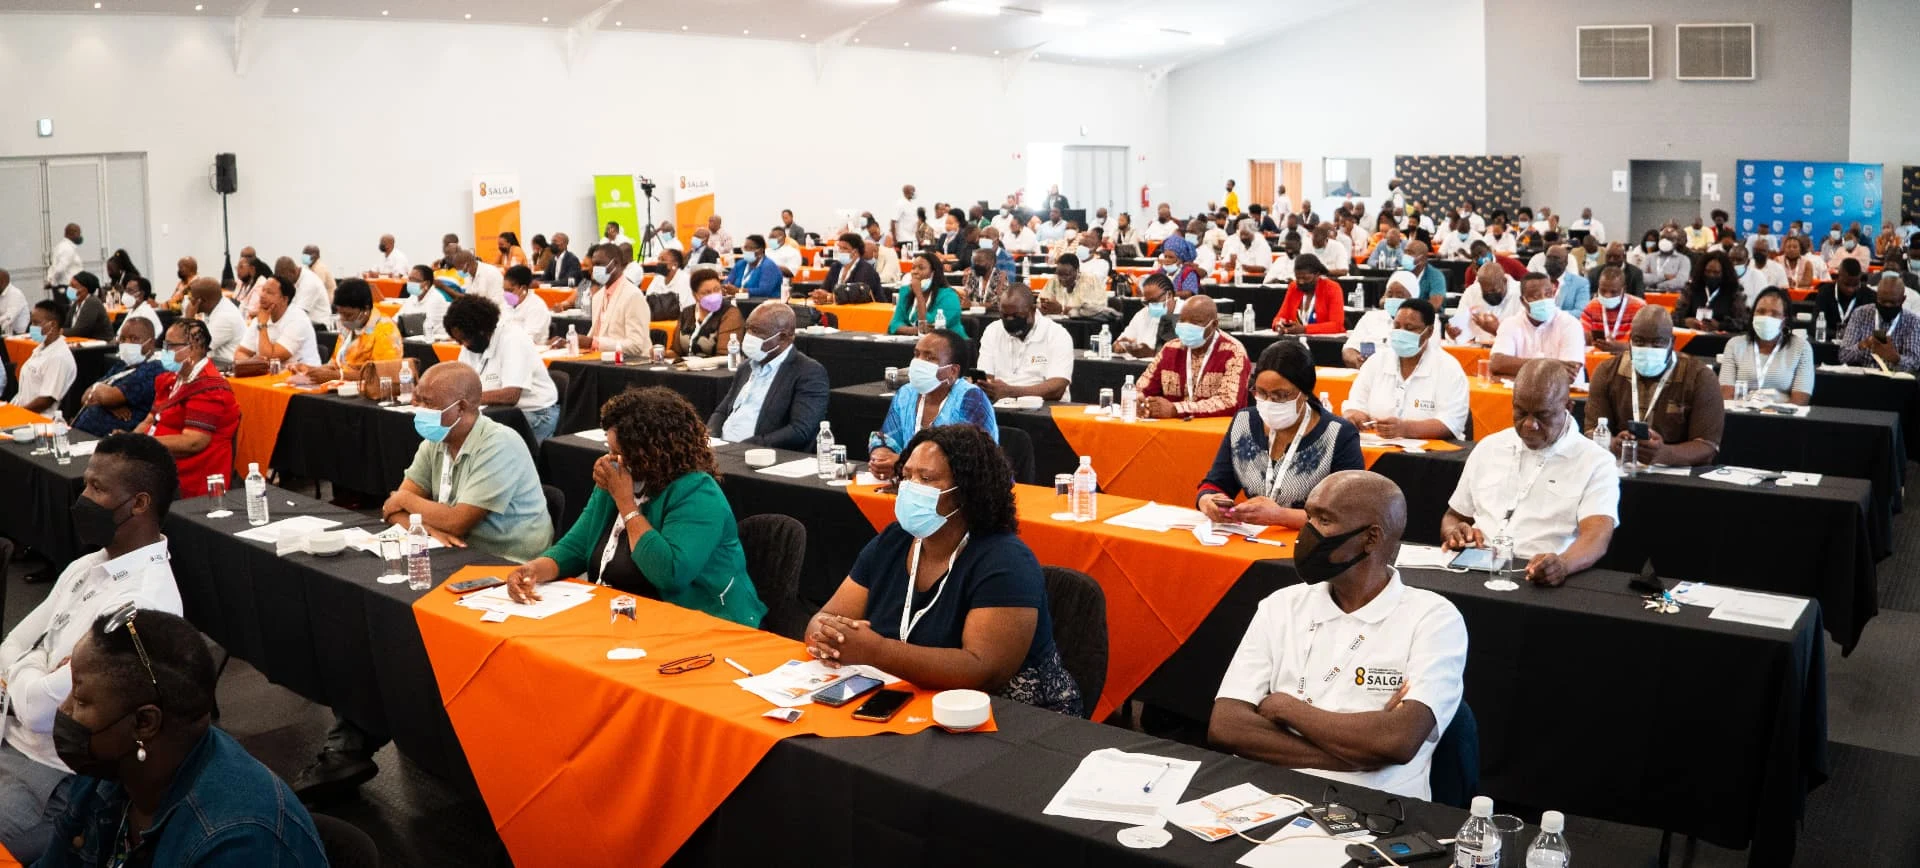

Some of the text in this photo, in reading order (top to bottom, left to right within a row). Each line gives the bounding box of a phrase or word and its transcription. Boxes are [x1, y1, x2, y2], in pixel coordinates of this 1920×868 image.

[687, 180, 709, 188] SALGA
[488, 186, 514, 196] SALGA
[1367, 675, 1403, 686] SALGA
